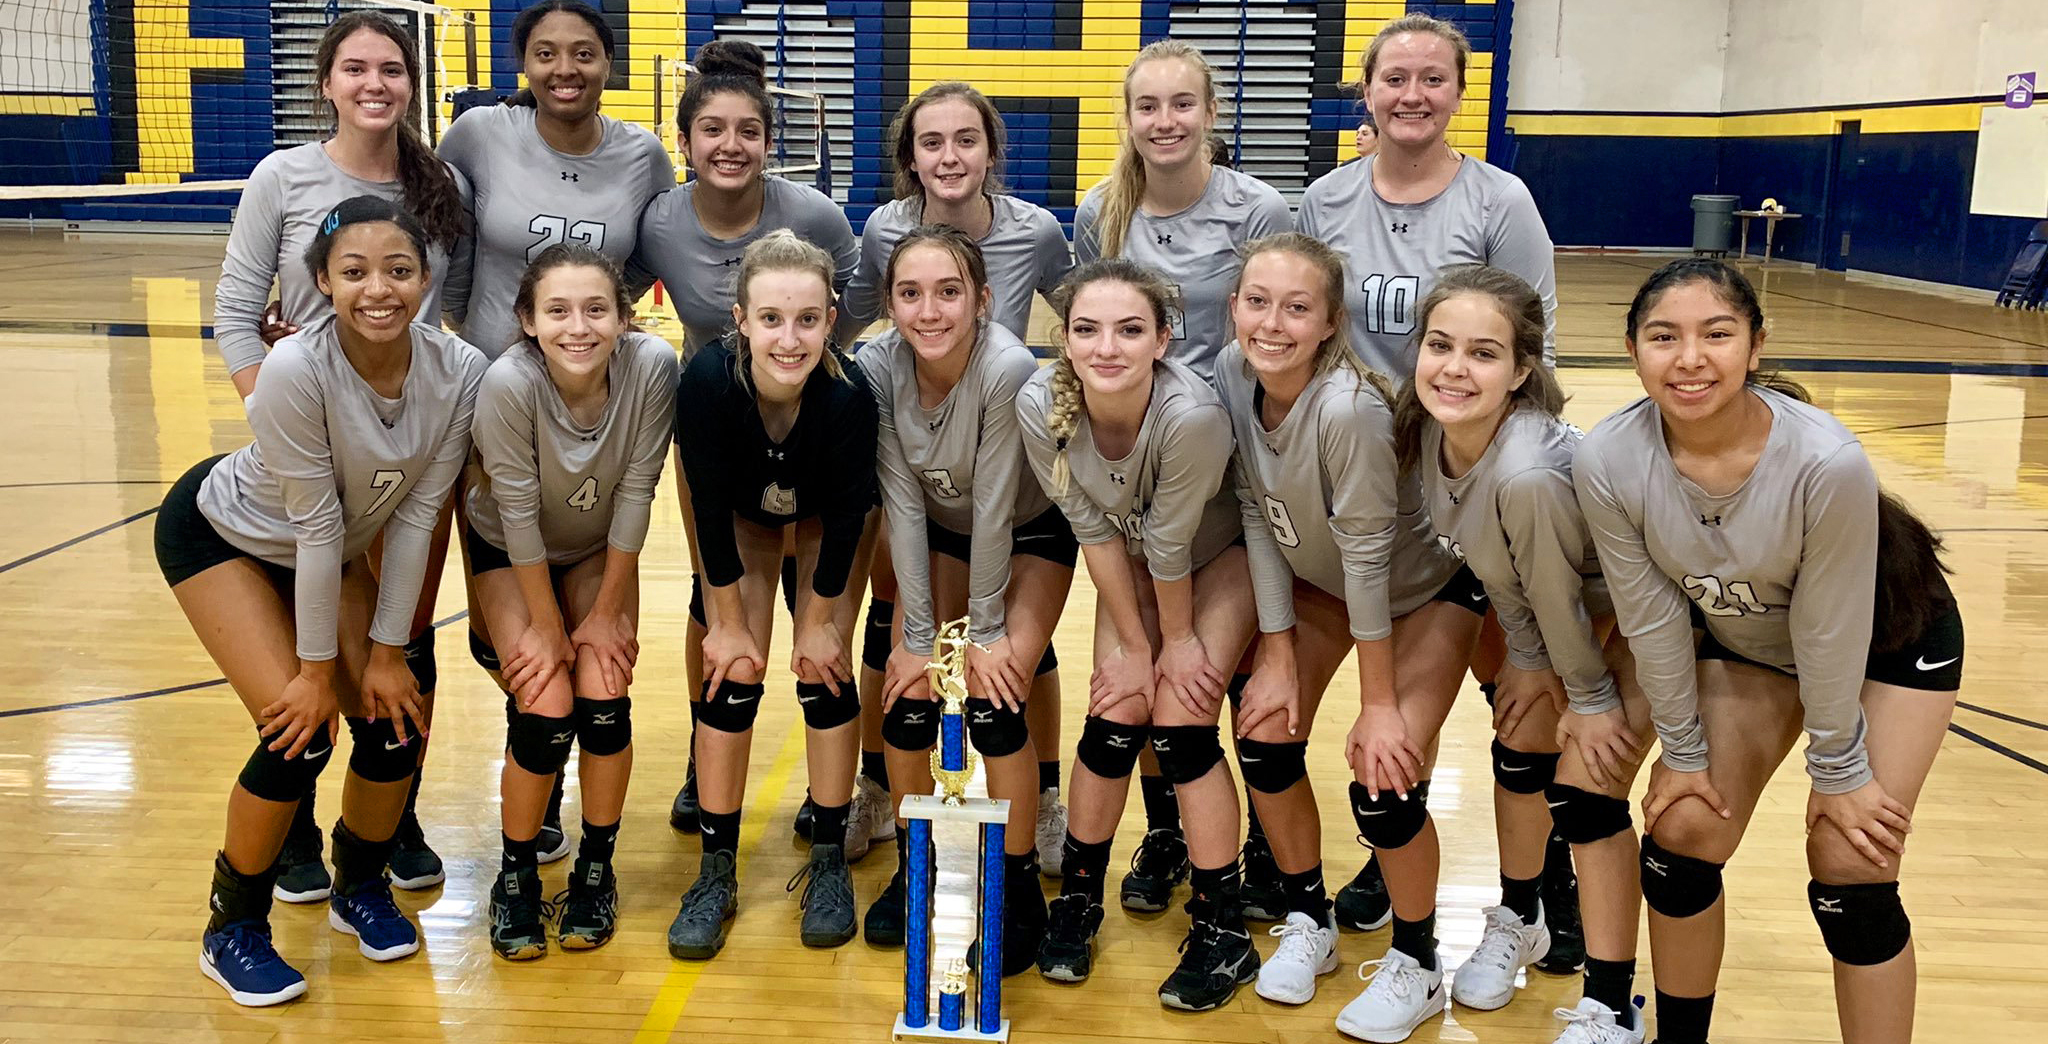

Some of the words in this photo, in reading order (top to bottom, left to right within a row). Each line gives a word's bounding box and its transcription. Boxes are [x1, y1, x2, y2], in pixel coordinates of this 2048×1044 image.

[1362, 273, 1419, 336] 10
[364, 469, 406, 517] 7
[567, 476, 600, 512] 4
[1264, 494, 1301, 549] 9
[1681, 574, 1769, 617] 21
[947, 957, 965, 971] 19
